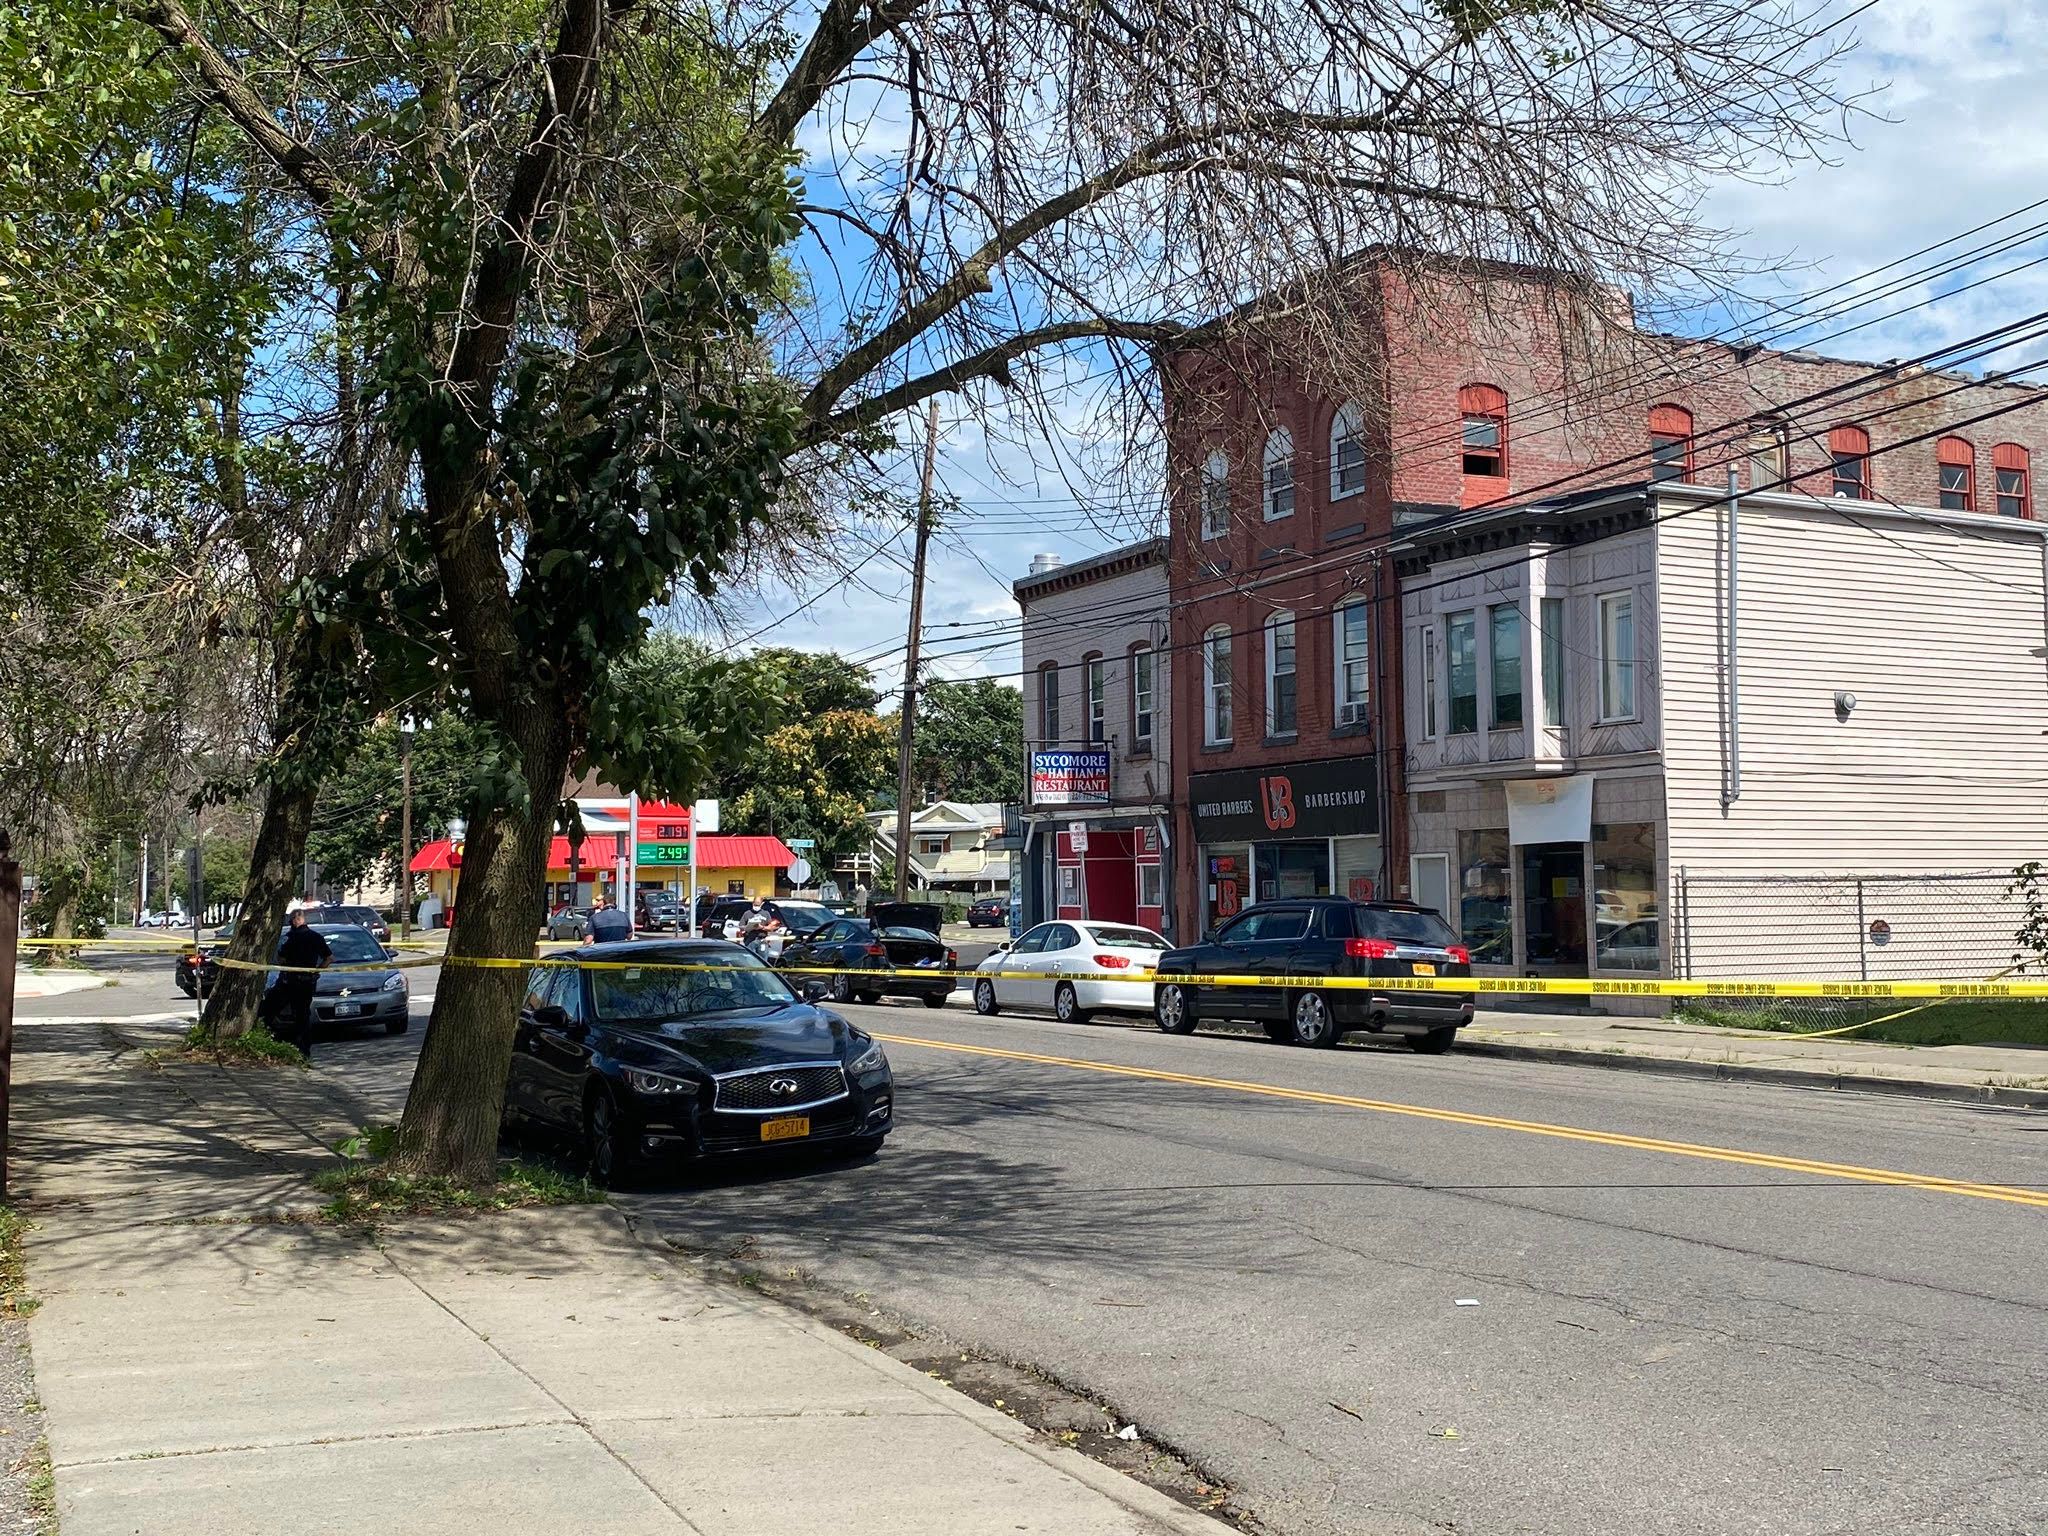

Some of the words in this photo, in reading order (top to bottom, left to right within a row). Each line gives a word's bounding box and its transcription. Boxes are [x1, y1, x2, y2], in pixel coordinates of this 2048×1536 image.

[1035, 755, 1106, 767] SYCOMORE
[1048, 767, 1094, 779] HAITIAN
[1035, 780, 1106, 791] RESTAURANT
[1304, 790, 1366, 808] BARBERSHOP
[1197, 802, 1221, 818] UNITED
[1222, 800, 1254, 816] BARBERS
[1480, 980, 1496, 990] CROSS
[1497, 980, 1507, 990] NOT
[1508, 981, 1516, 991] DO
[1517, 981, 1528, 991] LINE
[1529, 981, 1546, 991] POLICE
[1593, 982, 1609, 992] CROSS
[1610, 982, 1621, 992] NOT
[1622, 983, 1629, 992] DO
[1630, 983, 1641, 993] LINE
[1642, 983, 1660, 993] POLICE
[1707, 984, 1724, 994] CROSS
[1725, 984, 1736, 994] NOT
[1737, 984, 1744, 994] DO
[1745, 984, 1756, 994] LINE
[1757, 984, 1775, 994] POLICE
[1823, 985, 1839, 995] CROSS
[1841, 985, 1851, 995] NOT
[1853, 985, 1860, 995] DO
[1861, 985, 1872, 995] LINE
[1873, 985, 1891, 995] POLICE
[1940, 985, 1957, 995] CROSS
[1958, 985, 1969, 995] NOT
[1970, 985, 1977, 995] DO
[1978, 985, 1990, 995] LINE
[1991, 985, 2009, 995] POLICE
